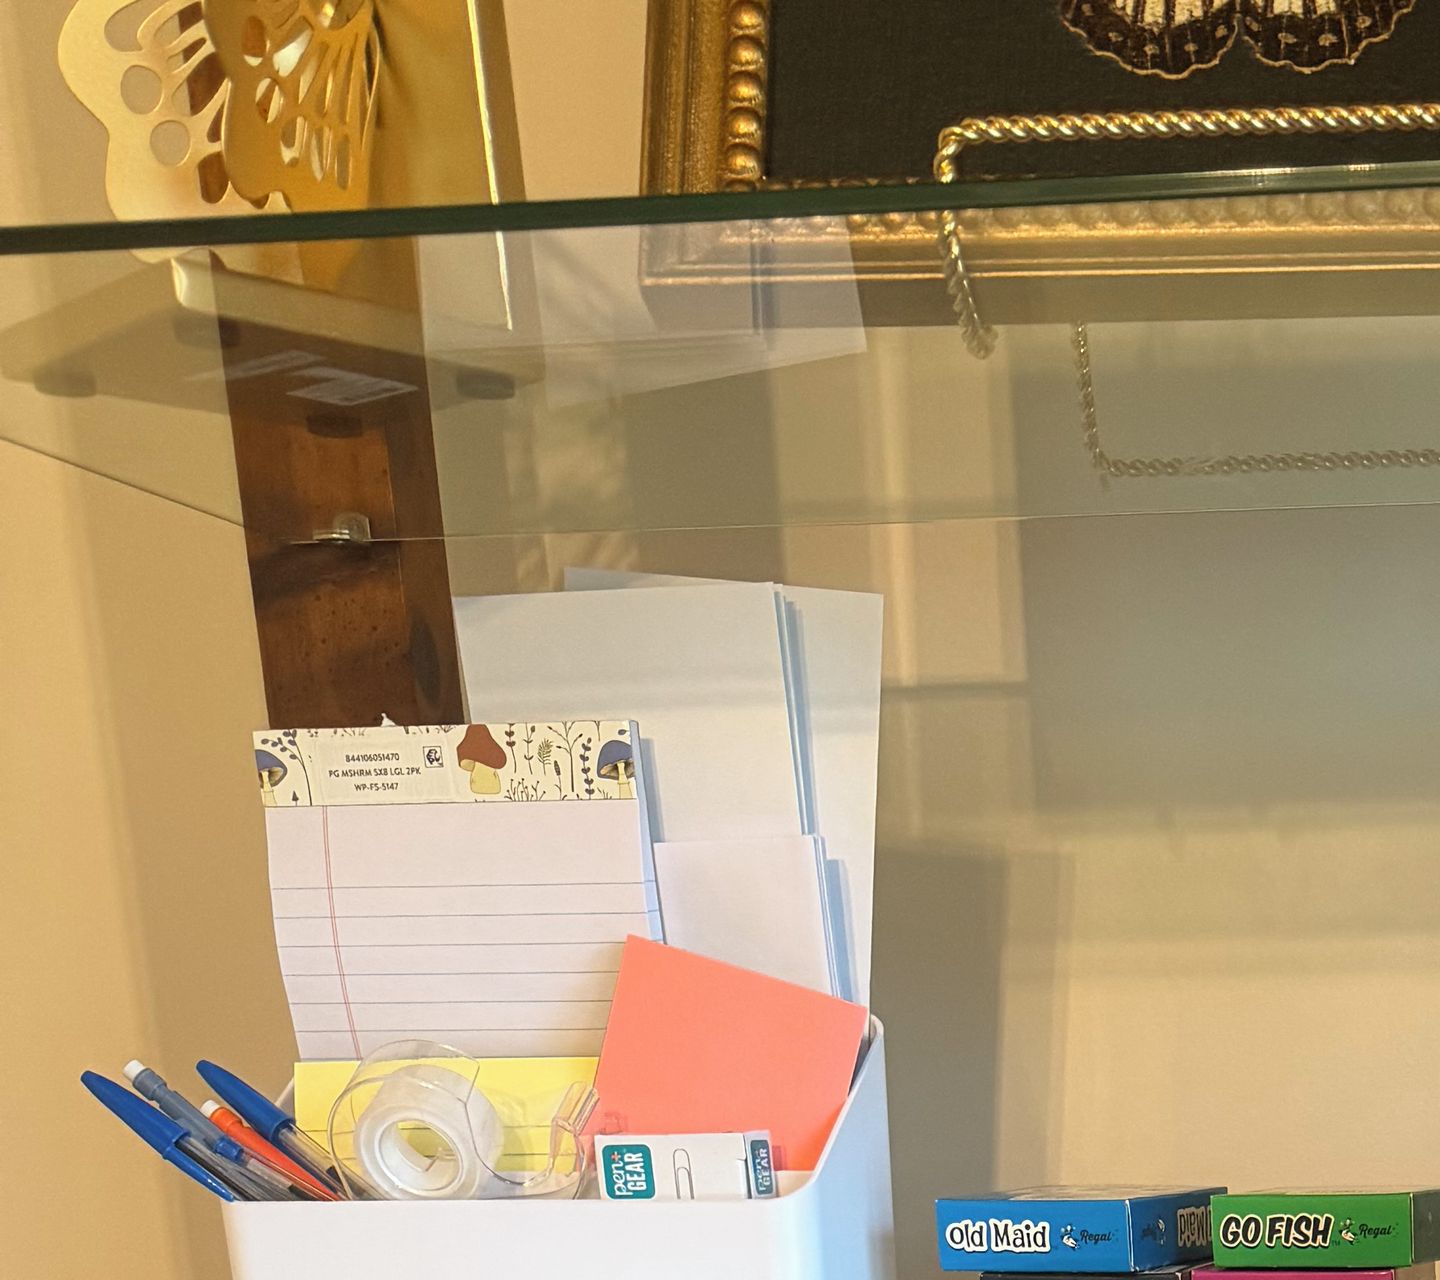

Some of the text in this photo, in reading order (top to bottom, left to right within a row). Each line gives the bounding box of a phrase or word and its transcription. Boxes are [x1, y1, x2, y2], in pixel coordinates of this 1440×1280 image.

[624, 1151, 647, 1192] GEAR
[949, 1218, 1050, 1252] Old Maid
[1079, 1229, 1113, 1244] Regal
[1220, 1215, 1261, 1247] GO
[1267, 1213, 1334, 1247] FISH
[1357, 1223, 1394, 1239] Regal
